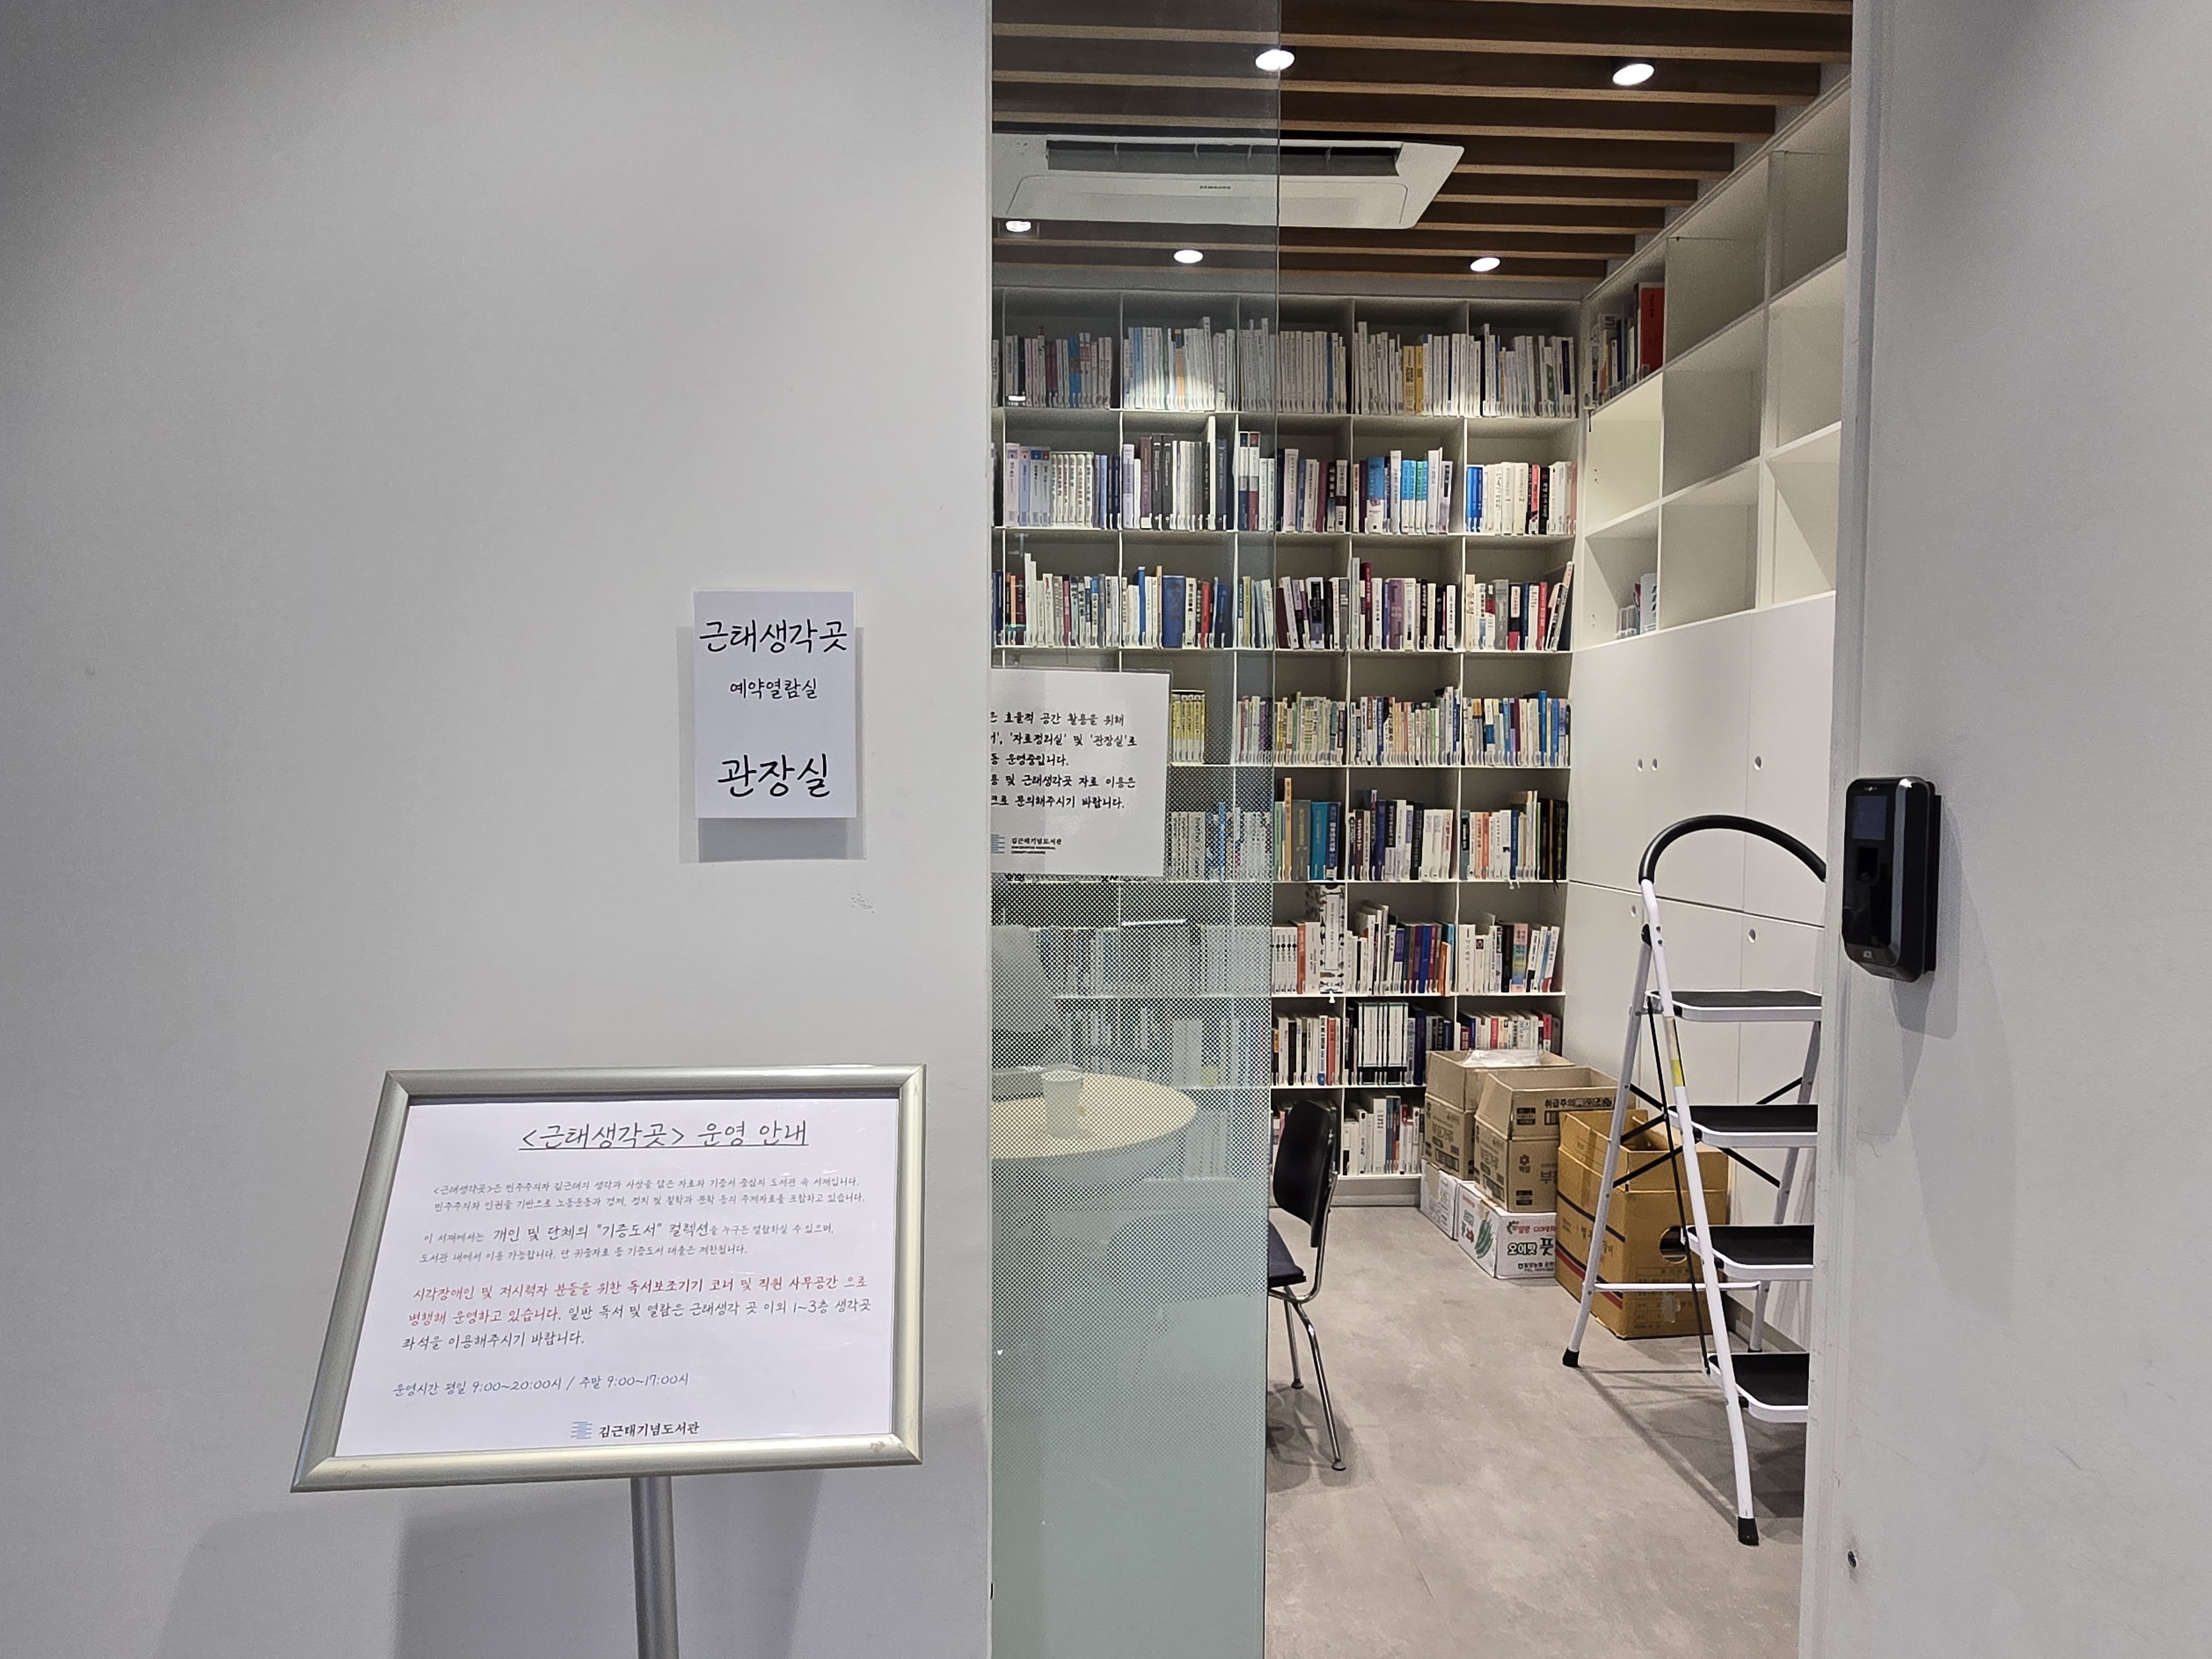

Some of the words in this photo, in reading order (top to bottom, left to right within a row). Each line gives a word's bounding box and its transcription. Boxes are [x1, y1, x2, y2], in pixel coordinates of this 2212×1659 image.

[699, 618, 848, 654] 근태생각곳
[730, 677, 818, 700] 예약열람실
[1003, 711, 1034, 725] 효율적
[1039, 712, 1062, 725] 공간
[1067, 712, 1099, 726] 활용을
[1103, 713, 1124, 727] 위해
[1073, 733, 1083, 747] 및
[1005, 753, 1069, 767] 운영중입니다.
[717, 753, 831, 798] 관장실
[1005, 773, 1016, 786] 및
[1021, 774, 1073, 787] 근태생각곳
[1078, 775, 1099, 788] 자료
[1105, 775, 1136, 789] 이용은
[1014, 794, 1075, 808] 문의해주시기
[1081, 795, 1125, 810] 바랍니다.
[522, 1121, 685, 1149] <근태생각곳>
[698, 1121, 745, 1146] 운영
[759, 1120, 806, 1145] 안내
[505, 1181, 550, 1193] 민주주의자
[594, 1180, 622, 1191] 생각과
[625, 1179, 653, 1190] 사상을
[770, 1177, 796, 1187] 도서관
[653, 1195, 661, 1206] 및
[424, 1233, 433, 1244] 이
[493, 1226, 520, 1243] 개인
[528, 1225, 540, 1242] 및
[547, 1224, 588, 1240] 단체의
[597, 1222, 662, 1239] "기증도서"
[669, 1221, 718, 1238] 컬렉션을
[792, 1224, 802, 1234] 수
[1507, 1242, 1537, 1255] 오이맛
[1540, 1238, 1553, 1256] 풋
[419, 1252, 448, 1264] 도서관
[486, 1251, 504, 1261] 이용
[413, 1285, 474, 1302] 시각장애인
[481, 1285, 493, 1300] 및
[499, 1282, 549, 1298] 저시력자
[554, 1281, 592, 1297] 분들을
[596, 1280, 622, 1295] 위한
[627, 1278, 703, 1295] 독서보조기기
[709, 1277, 734, 1292] 코너
[740, 1277, 752, 1292] 및
[758, 1276, 782, 1291] 직원
[788, 1275, 838, 1291] 사무공간
[843, 1275, 868, 1288] 으로
[409, 1311, 447, 1327] 병행해
[452, 1309, 502, 1324] 운영하고
[507, 1306, 561, 1323] 있습니다.
[568, 1305, 593, 1321] 일반
[598, 1304, 624, 1319] 독서
[629, 1303, 640, 1318] 및
[647, 1302, 685, 1318] 열람은
[689, 1301, 740, 1316] 근태생각
[745, 1301, 758, 1315] 곳
[764, 1300, 786, 1314] 이외
[834, 1298, 871, 1313] 생각곳
[401, 1335, 443, 1351] 좌석을
[448, 1331, 525, 1349] 이용해주시기
[531, 1330, 585, 1347] 바랍니다.
[393, 1381, 440, 1397] 운영시간
[444, 1380, 467, 1395] 평일
[472, 1376, 562, 1394] 9:00~20:00시
[565, 1376, 576, 1391] /
[578, 1375, 602, 1390] 주말
[607, 1372, 688, 1388] 9:00~17:00시
[598, 1421, 700, 1438] 김근태기념도서관
